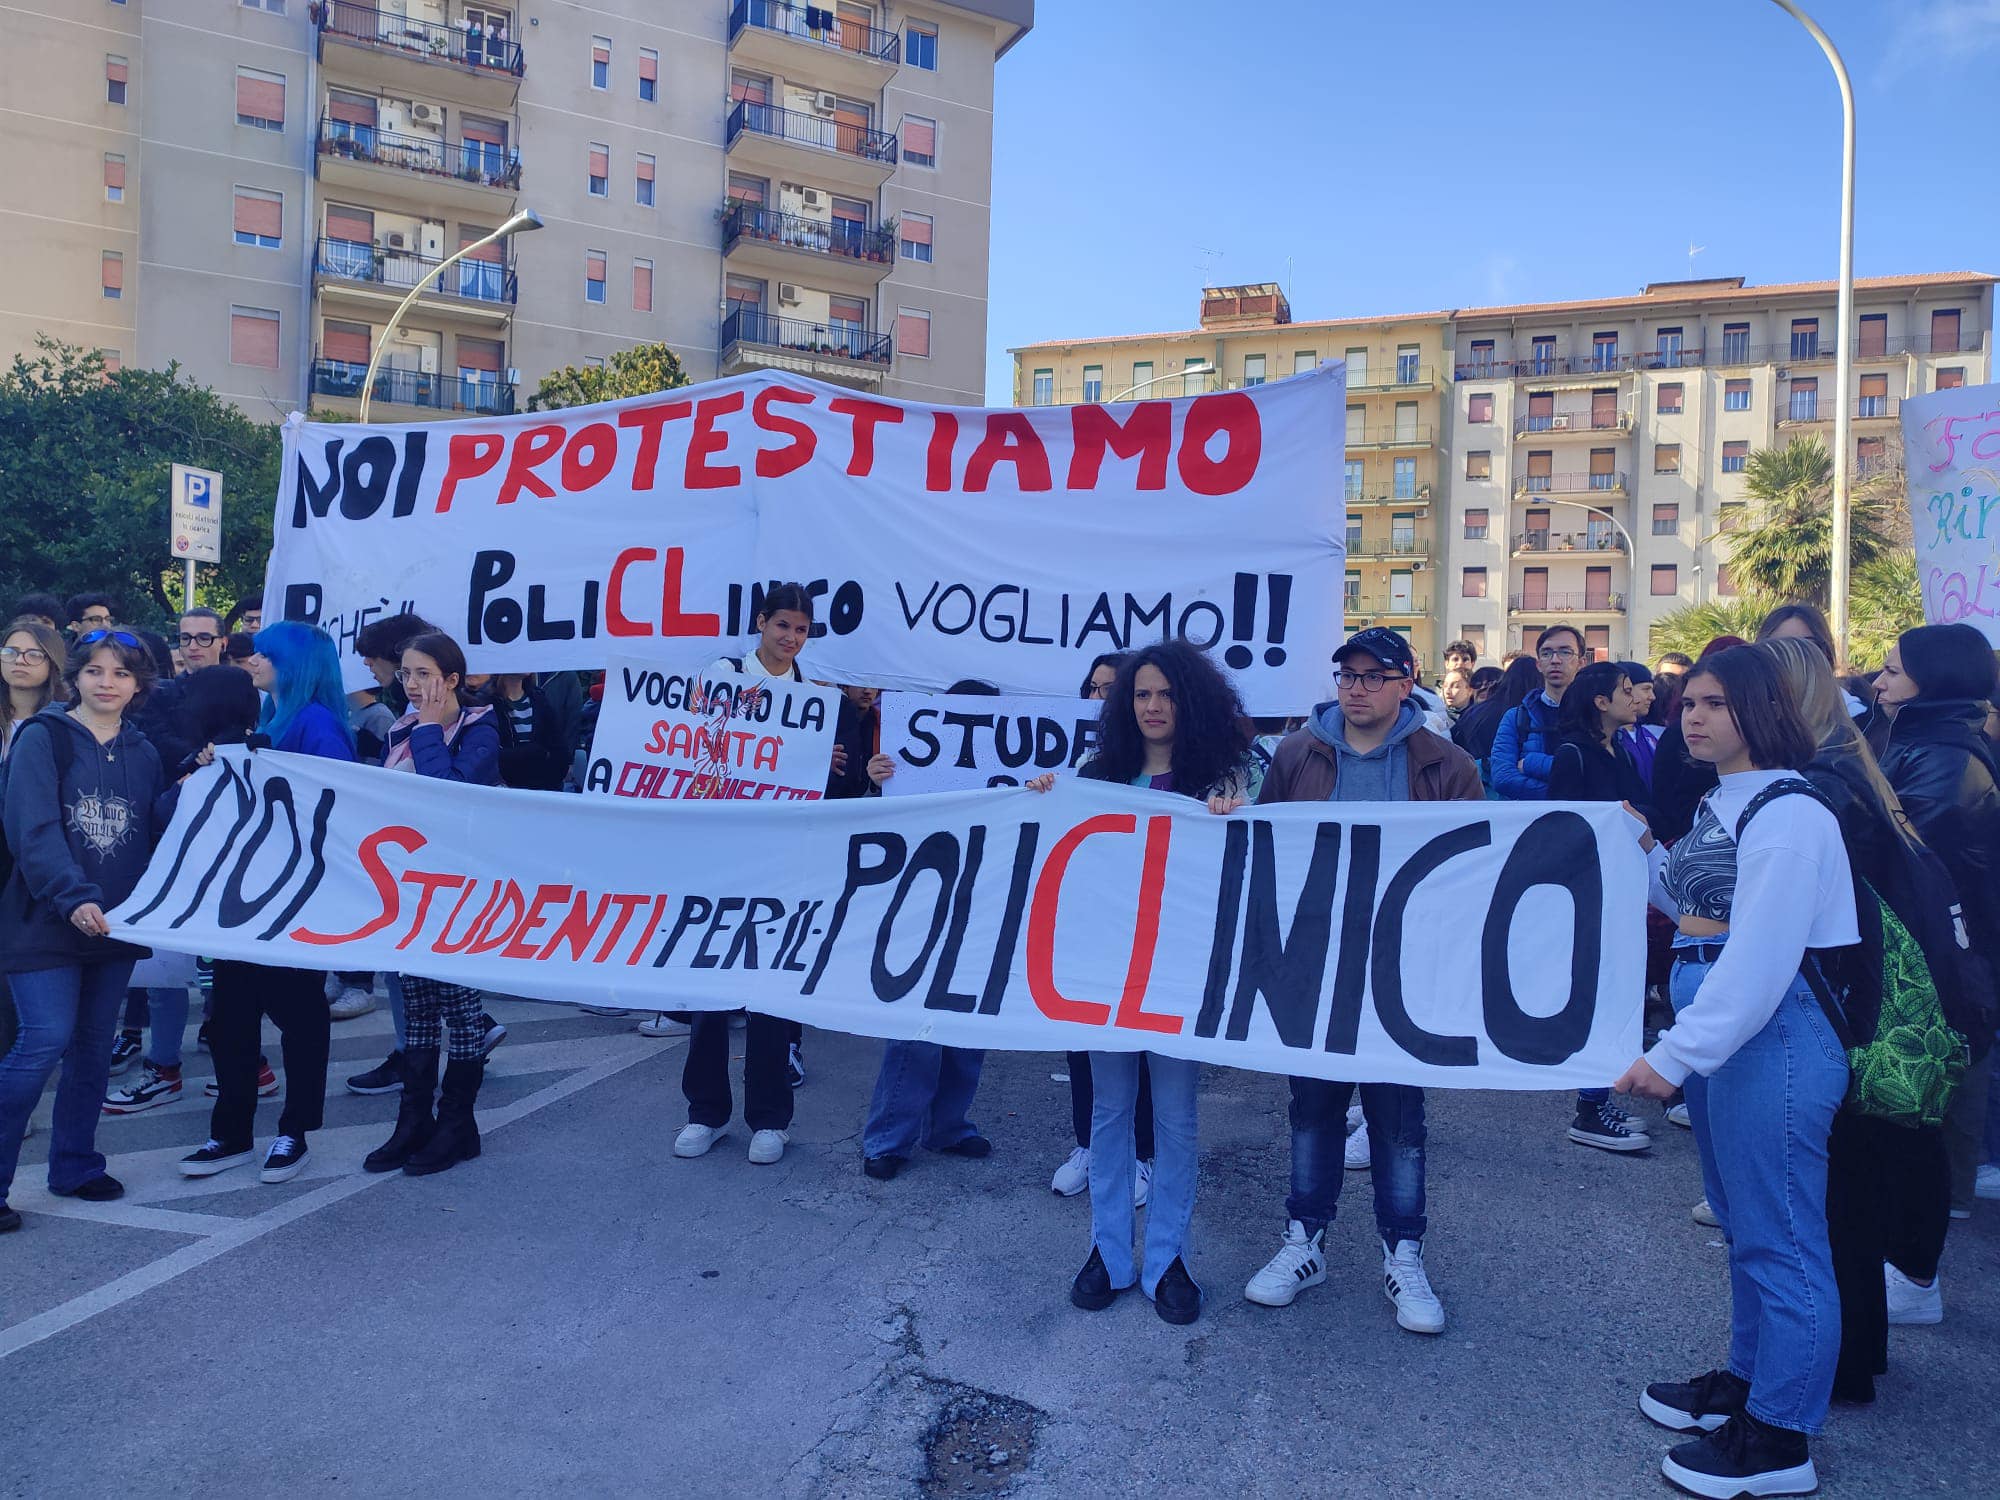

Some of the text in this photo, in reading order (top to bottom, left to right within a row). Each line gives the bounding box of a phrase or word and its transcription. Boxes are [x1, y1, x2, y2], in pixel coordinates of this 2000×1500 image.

[292, 386, 1262, 528] NOI PROTESTIAMO
[189, 476, 206, 503] P
[468, 547, 864, 645] POLICLINCO
[623, 667, 825, 732] VOGLIAMO LA
[644, 720, 784, 772] SANITÀ
[898, 709, 1102, 769] STUDE
[587, 758, 613, 793] A
[126, 757, 335, 941] NOI
[290, 826, 666, 966] STUDENTI
[802, 810, 1603, 1066] POLICLINICO
